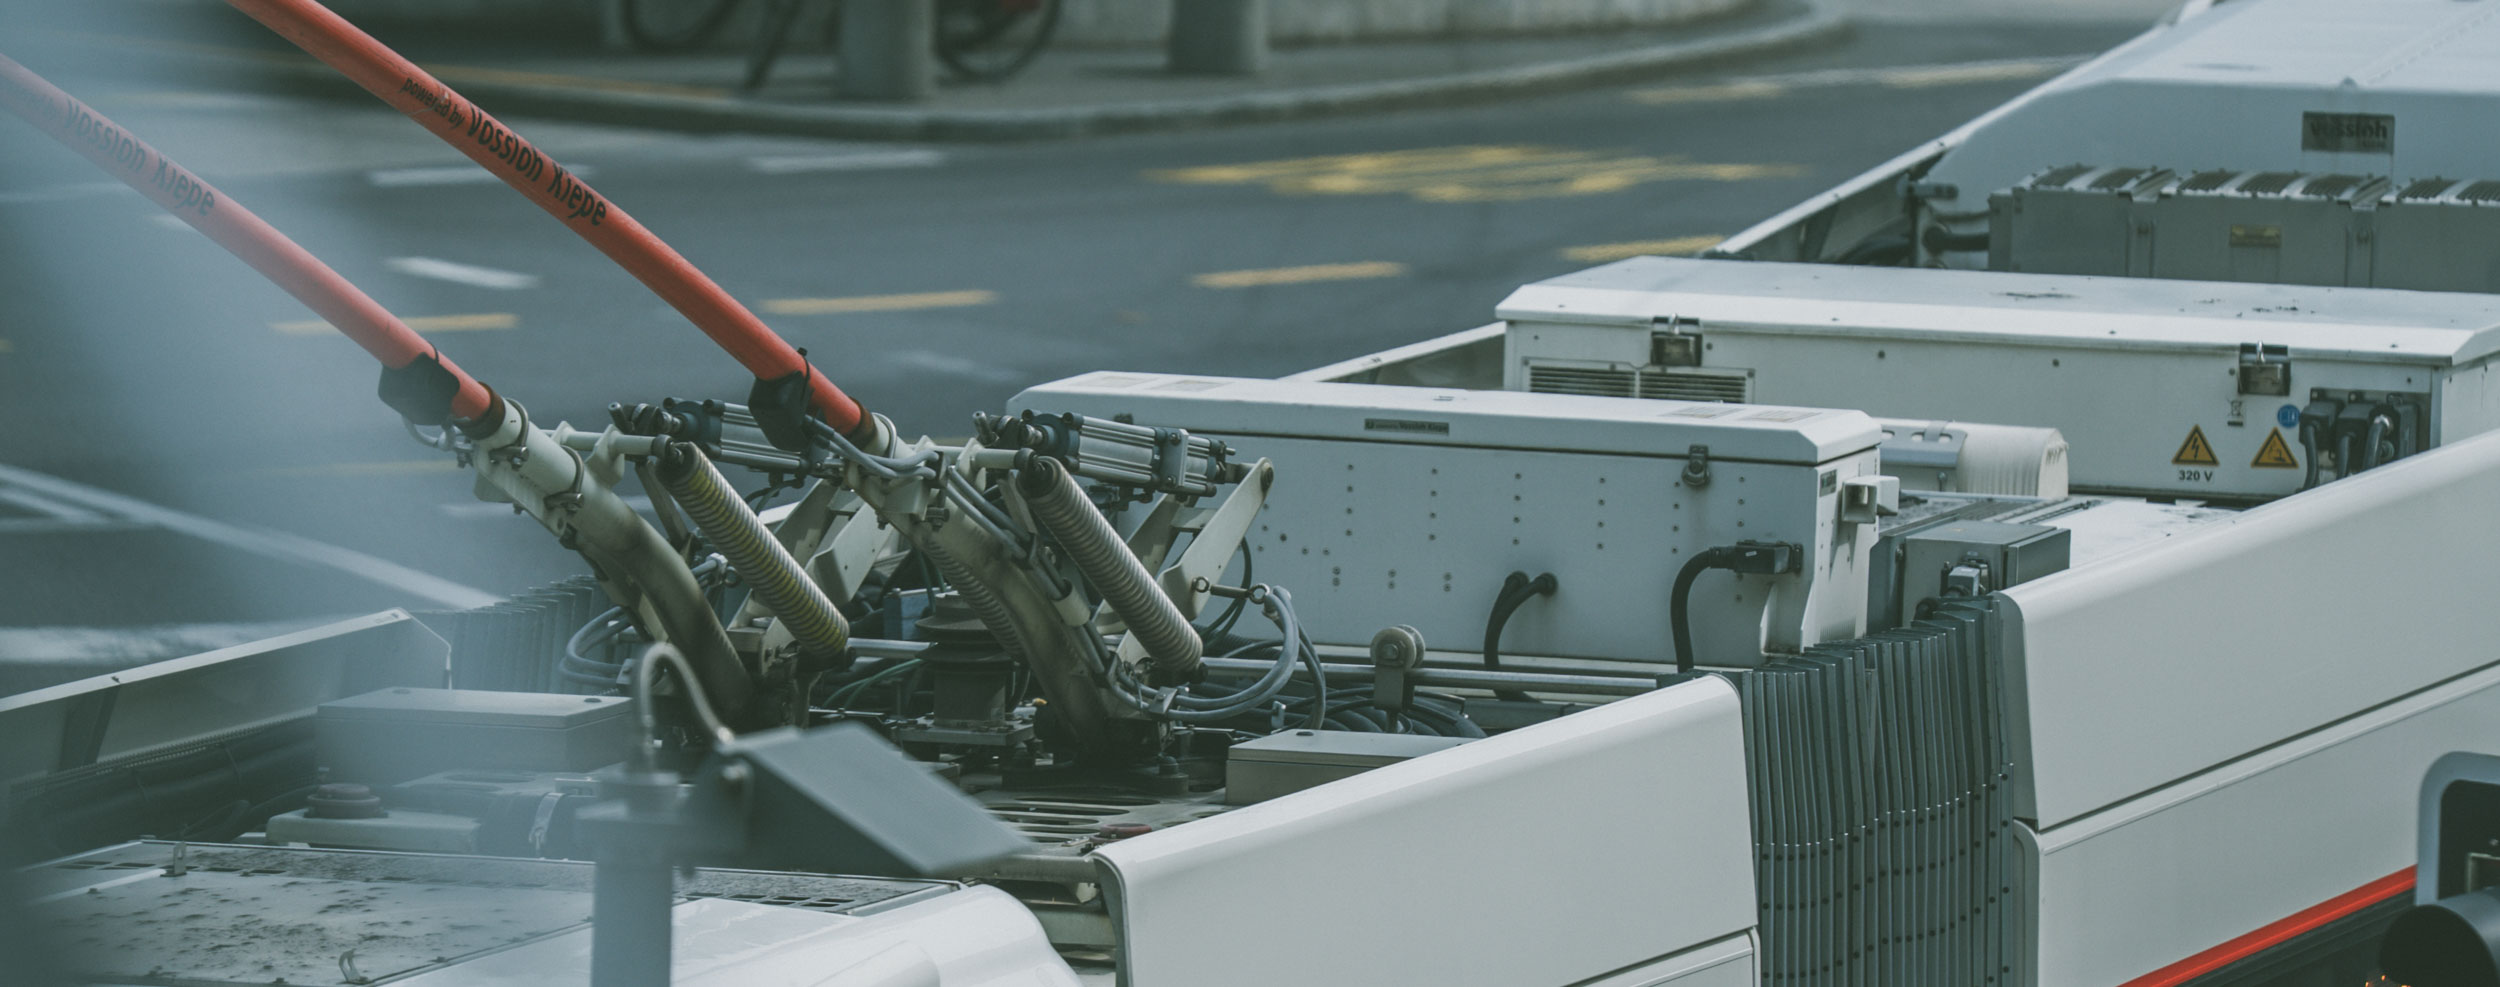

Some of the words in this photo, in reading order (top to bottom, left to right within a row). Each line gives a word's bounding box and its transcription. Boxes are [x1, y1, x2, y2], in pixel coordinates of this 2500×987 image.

[64, 99, 146, 173] Vossloh
[151, 155, 215, 216] Kiepe
[401, 77, 451, 118] powered
[448, 104, 465, 128] by
[467, 105, 543, 181] Vossloh
[546, 161, 606, 226] Kiepe
[2178, 470, 2200, 481] 320
[2204, 471, 2213, 481] V
